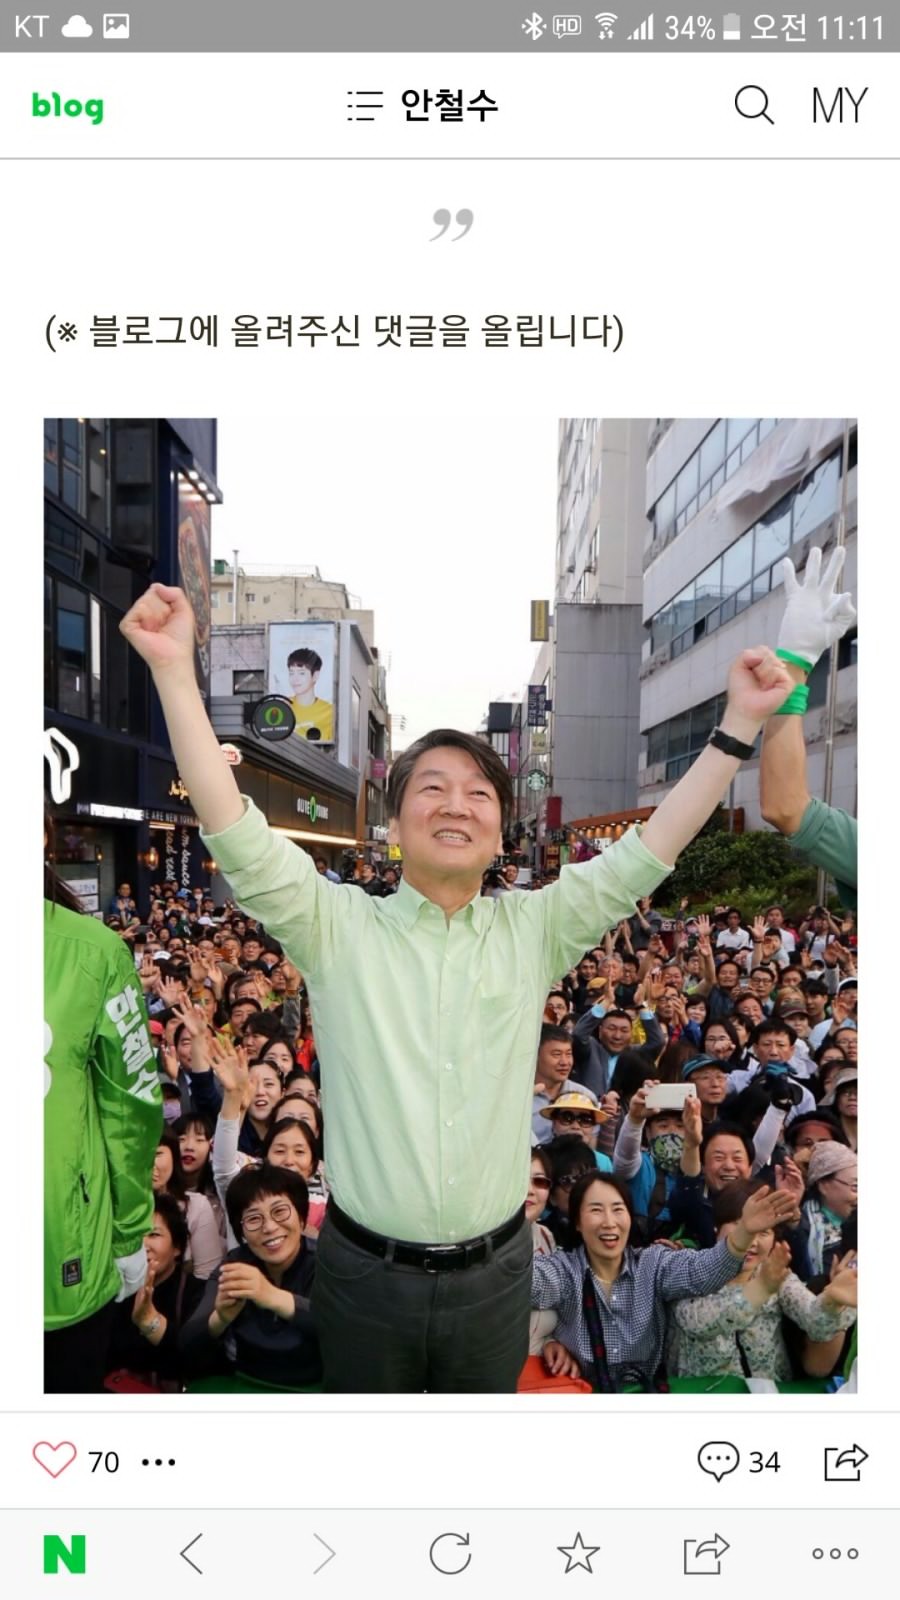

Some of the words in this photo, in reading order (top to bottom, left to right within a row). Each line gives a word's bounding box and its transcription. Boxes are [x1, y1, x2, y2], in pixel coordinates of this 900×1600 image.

[15, 15, 49, 38] KT
[556, 18, 578, 32] HD
[665, 15, 716, 40] 34%
[751, 14, 807, 42] 오전
[817, 15, 883, 40] 11:11
[31, 91, 105, 126] blog
[400, 88, 499, 123] 안철수
[812, 86, 870, 124] MY
[89, 314, 218, 348] 블로그에
[230, 314, 361, 348] 올려주신
[374, 314, 470, 348] 댓글을
[480, 313, 624, 353] 올립니다)
[87, 1450, 120, 1474] 70
[748, 1450, 782, 1474] 34
[42, 1534, 87, 1575] N
